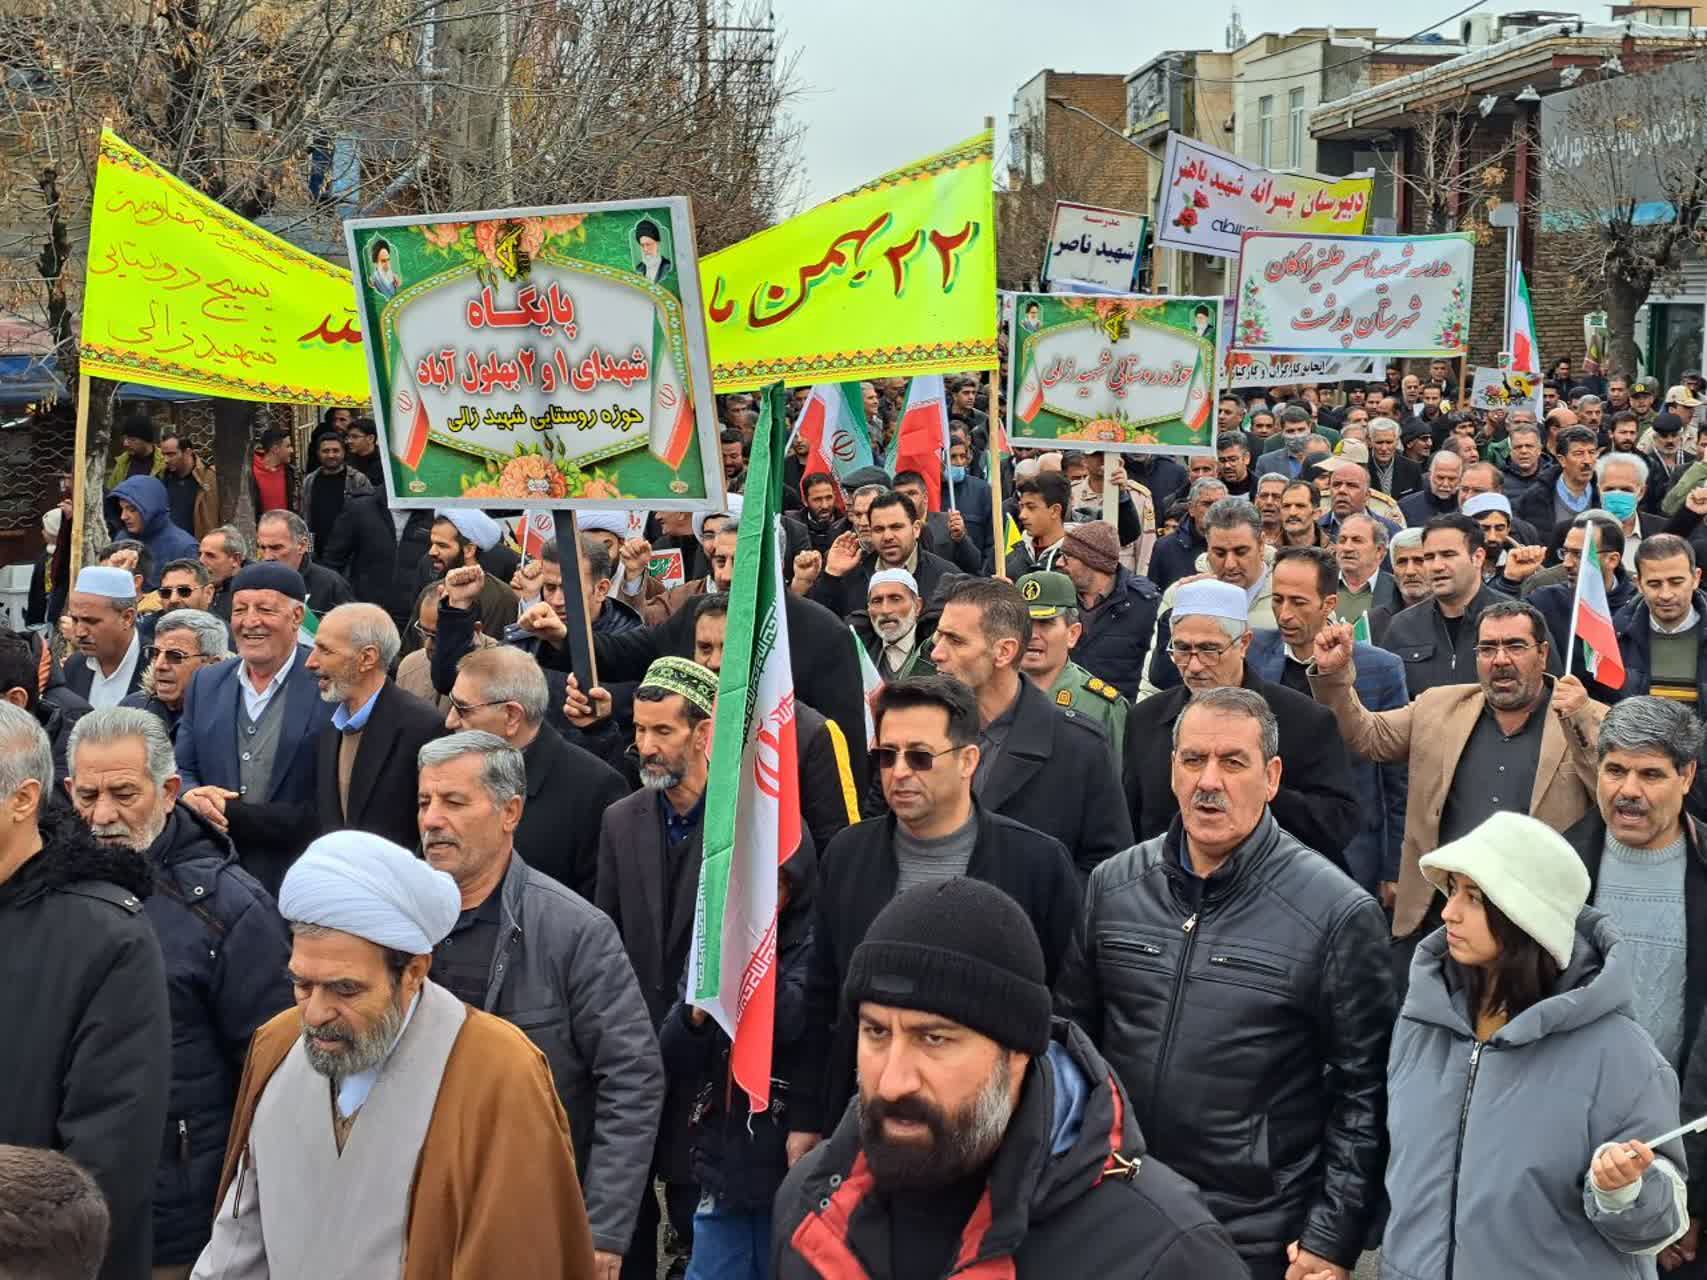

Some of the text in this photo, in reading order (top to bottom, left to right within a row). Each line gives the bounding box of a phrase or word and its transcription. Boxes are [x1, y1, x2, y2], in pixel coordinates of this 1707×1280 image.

[1173, 155, 1364, 219] دبیرستان پسرانه شهید باهنر
[1083, 215, 1121, 228] مدرسه
[1053, 233, 1135, 264] شهید ناصر
[1374, 242, 1415, 293] شهید
[747, 211, 894, 330] بهمن
[202, 277, 274, 321] بسیج
[466, 283, 577, 340] پایگاه
[1290, 293, 1423, 347] شهرستان پلدشت
[108, 300, 195, 354] زالی
[193, 326, 277, 367] شهید
[416, 350, 456, 393] آباد
[462, 353, 520, 394] بهلول
[541, 362, 555, 392] و
[572, 348, 649, 391] شهدای
[1041, 358, 1075, 388] زالی
[1075, 350, 1113, 397] شهید
[1161, 362, 1194, 385] حوزه
[447, 404, 645, 433] حوزه روستایی شهید زالی
